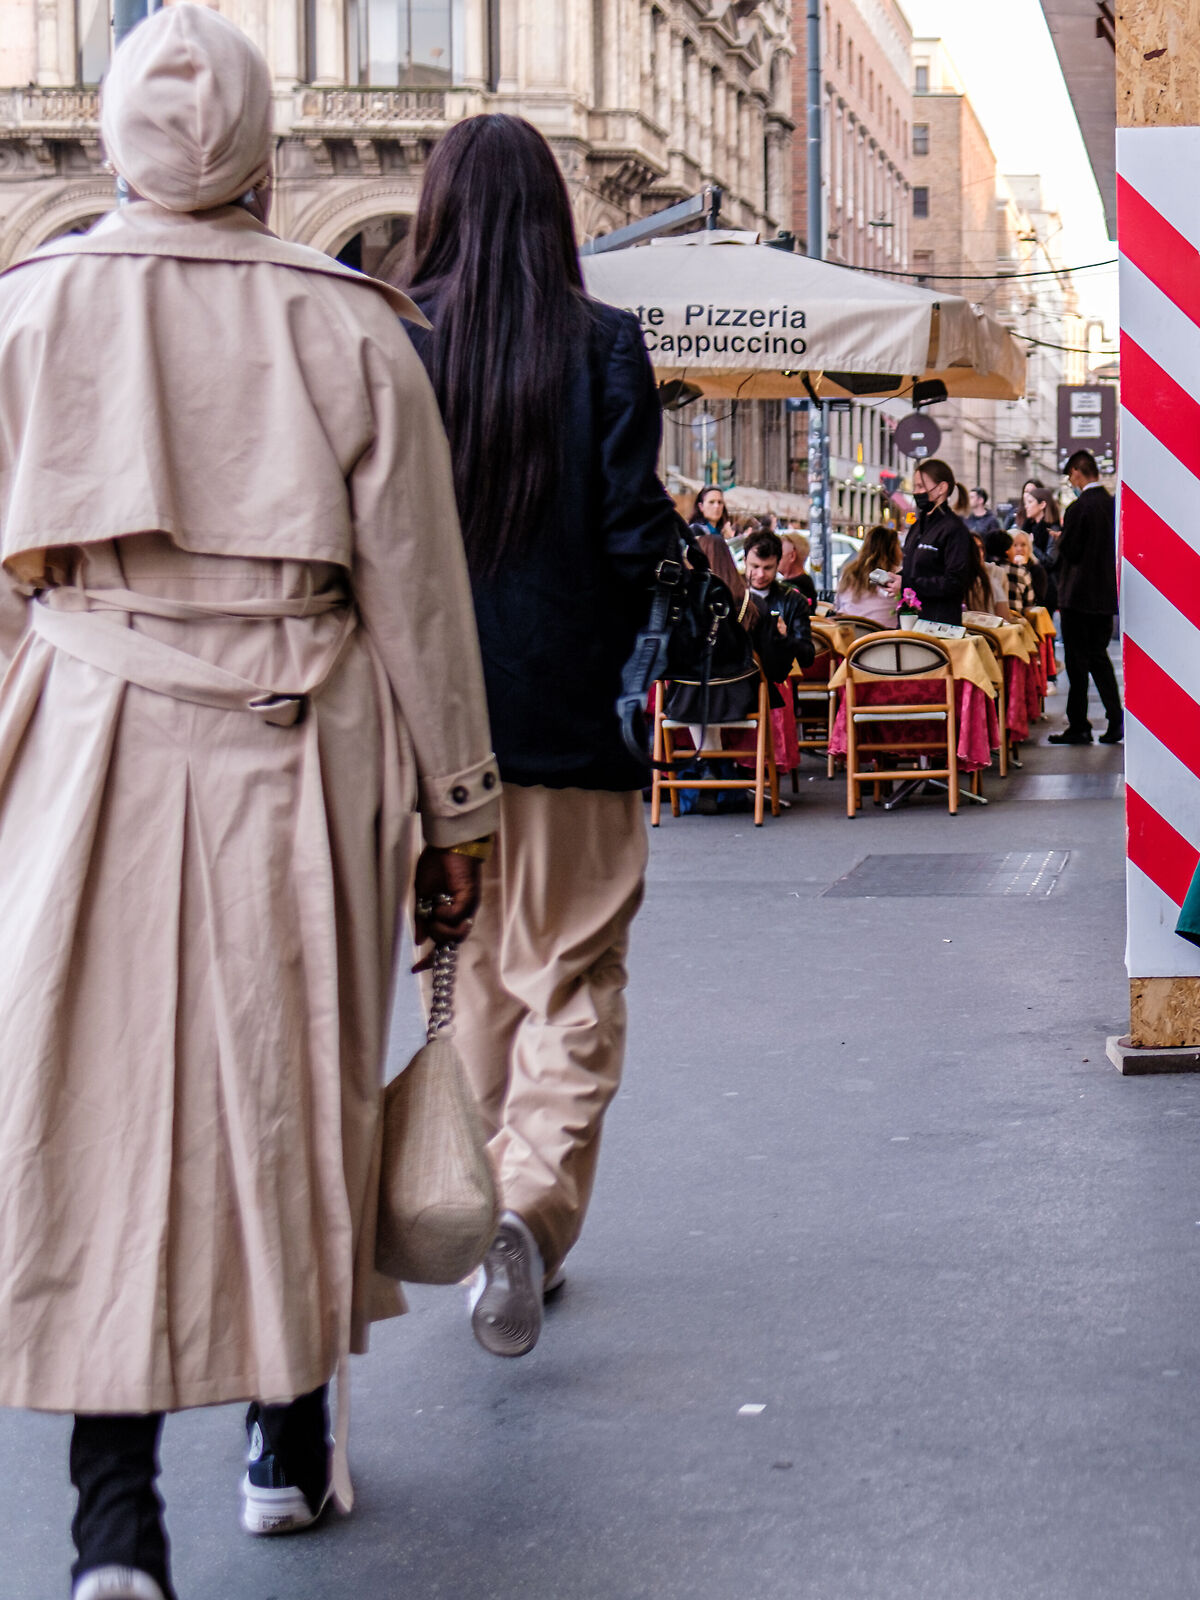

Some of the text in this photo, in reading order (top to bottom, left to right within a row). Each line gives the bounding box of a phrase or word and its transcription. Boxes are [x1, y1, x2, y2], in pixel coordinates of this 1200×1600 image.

[624, 304, 807, 328] te Pizzeria
[642, 329, 807, 357] Cappuccino
